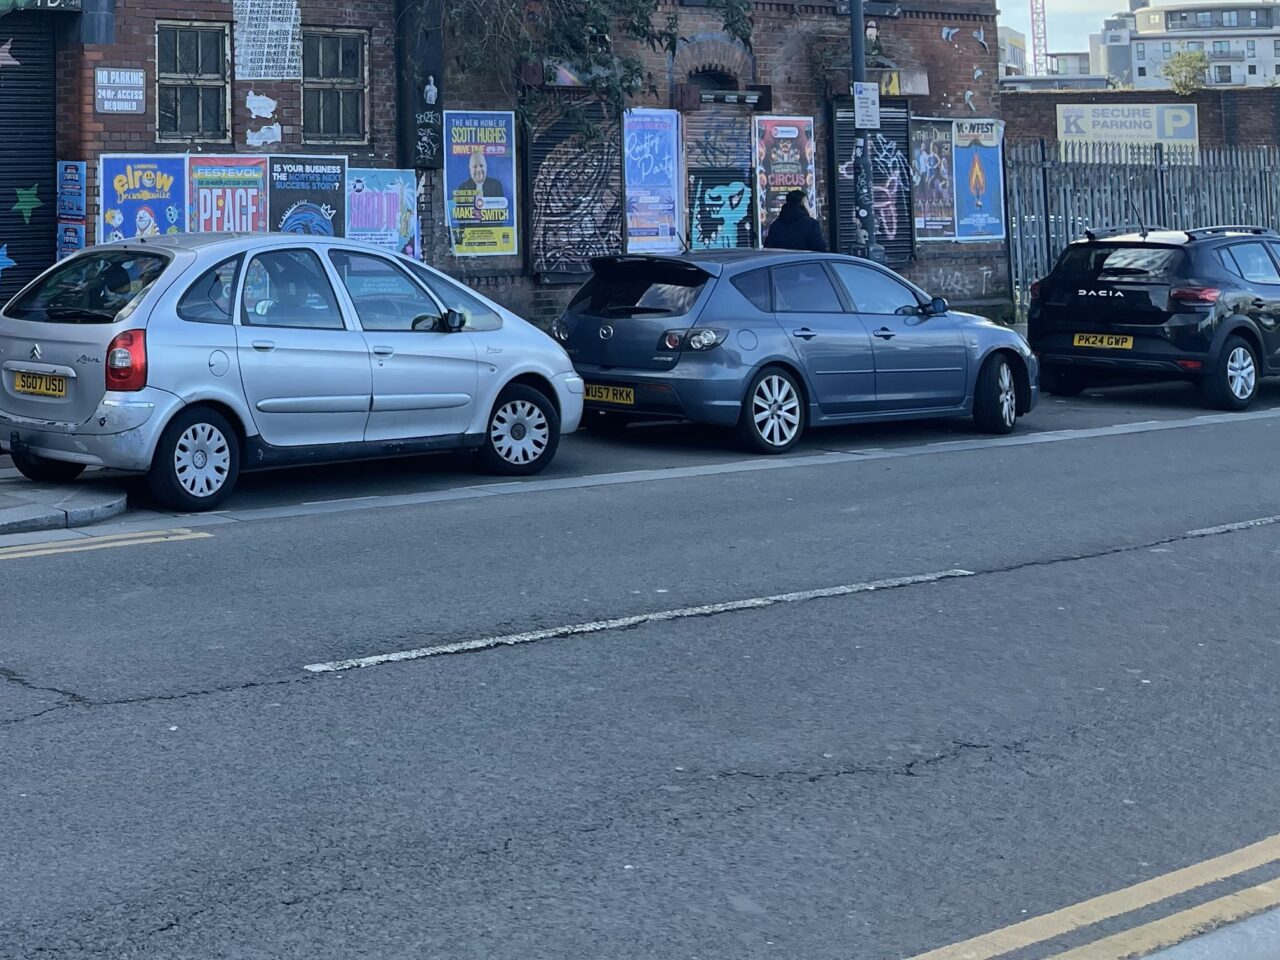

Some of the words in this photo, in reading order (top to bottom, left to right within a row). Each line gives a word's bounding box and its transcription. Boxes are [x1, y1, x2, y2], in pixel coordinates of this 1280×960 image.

[97, 71, 108, 84] NO
[110, 71, 143, 85] PARKING
[117, 90, 143, 100] ACCESS
[104, 100, 137, 111] REQUIRED
[1091, 108, 1151, 118] SECURE
[452, 119, 463, 127] THE
[465, 119, 479, 127] NEW
[480, 119, 497, 127] HOME
[1062, 114, 1086, 135] K
[1092, 120, 1153, 130] PARKING
[1164, 109, 1191, 137] P
[451, 126, 476, 143] SCOTT
[477, 127, 507, 144] HUGHES
[625, 133, 661, 161] Rooftop
[197, 169, 258, 177] FESTEVOL
[273, 164, 281, 172] IS
[282, 165, 304, 173] YOUR
[305, 165, 341, 173] BUSINESS
[638, 154, 674, 181] Party
[272, 173, 287, 181] THE
[322, 174, 342, 182] NEXT
[768, 174, 806, 186] CIRCUS
[275, 182, 310, 190] SUCCESS
[311, 182, 340, 190] STORY?
[453, 207, 475, 219] MAKE
[480, 209, 509, 221] SWITCH
[1078, 289, 1125, 297] DACIA
[1078, 335, 1104, 345] PK24
[1106, 336, 1128, 347] GWP
[21, 374, 43, 390] SG07
[45, 378, 64, 392] USD
[612, 388, 632, 402] RKK
